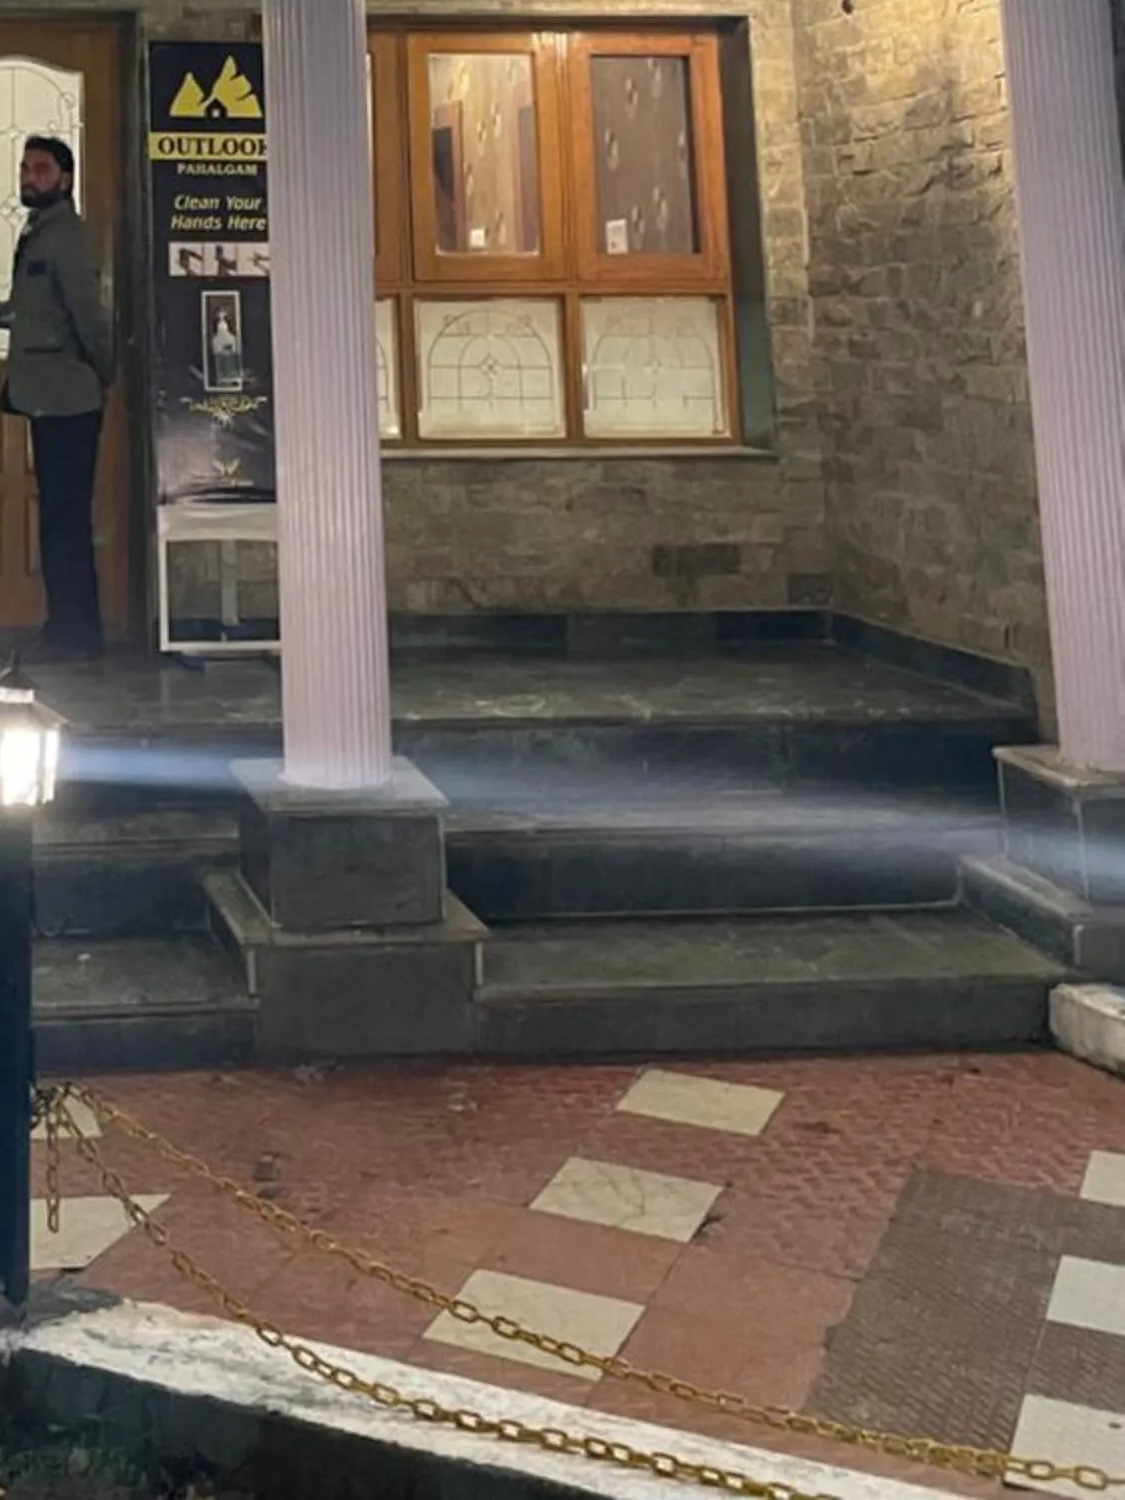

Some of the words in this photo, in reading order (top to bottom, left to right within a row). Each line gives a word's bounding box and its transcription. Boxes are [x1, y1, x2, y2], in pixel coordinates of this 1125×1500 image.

[177, 162, 258, 175] PAHALGAM
[174, 194, 220, 210] Clean
[226, 195, 262, 210] Your
[171, 214, 222, 230] Hands
[227, 214, 267, 230] Here
